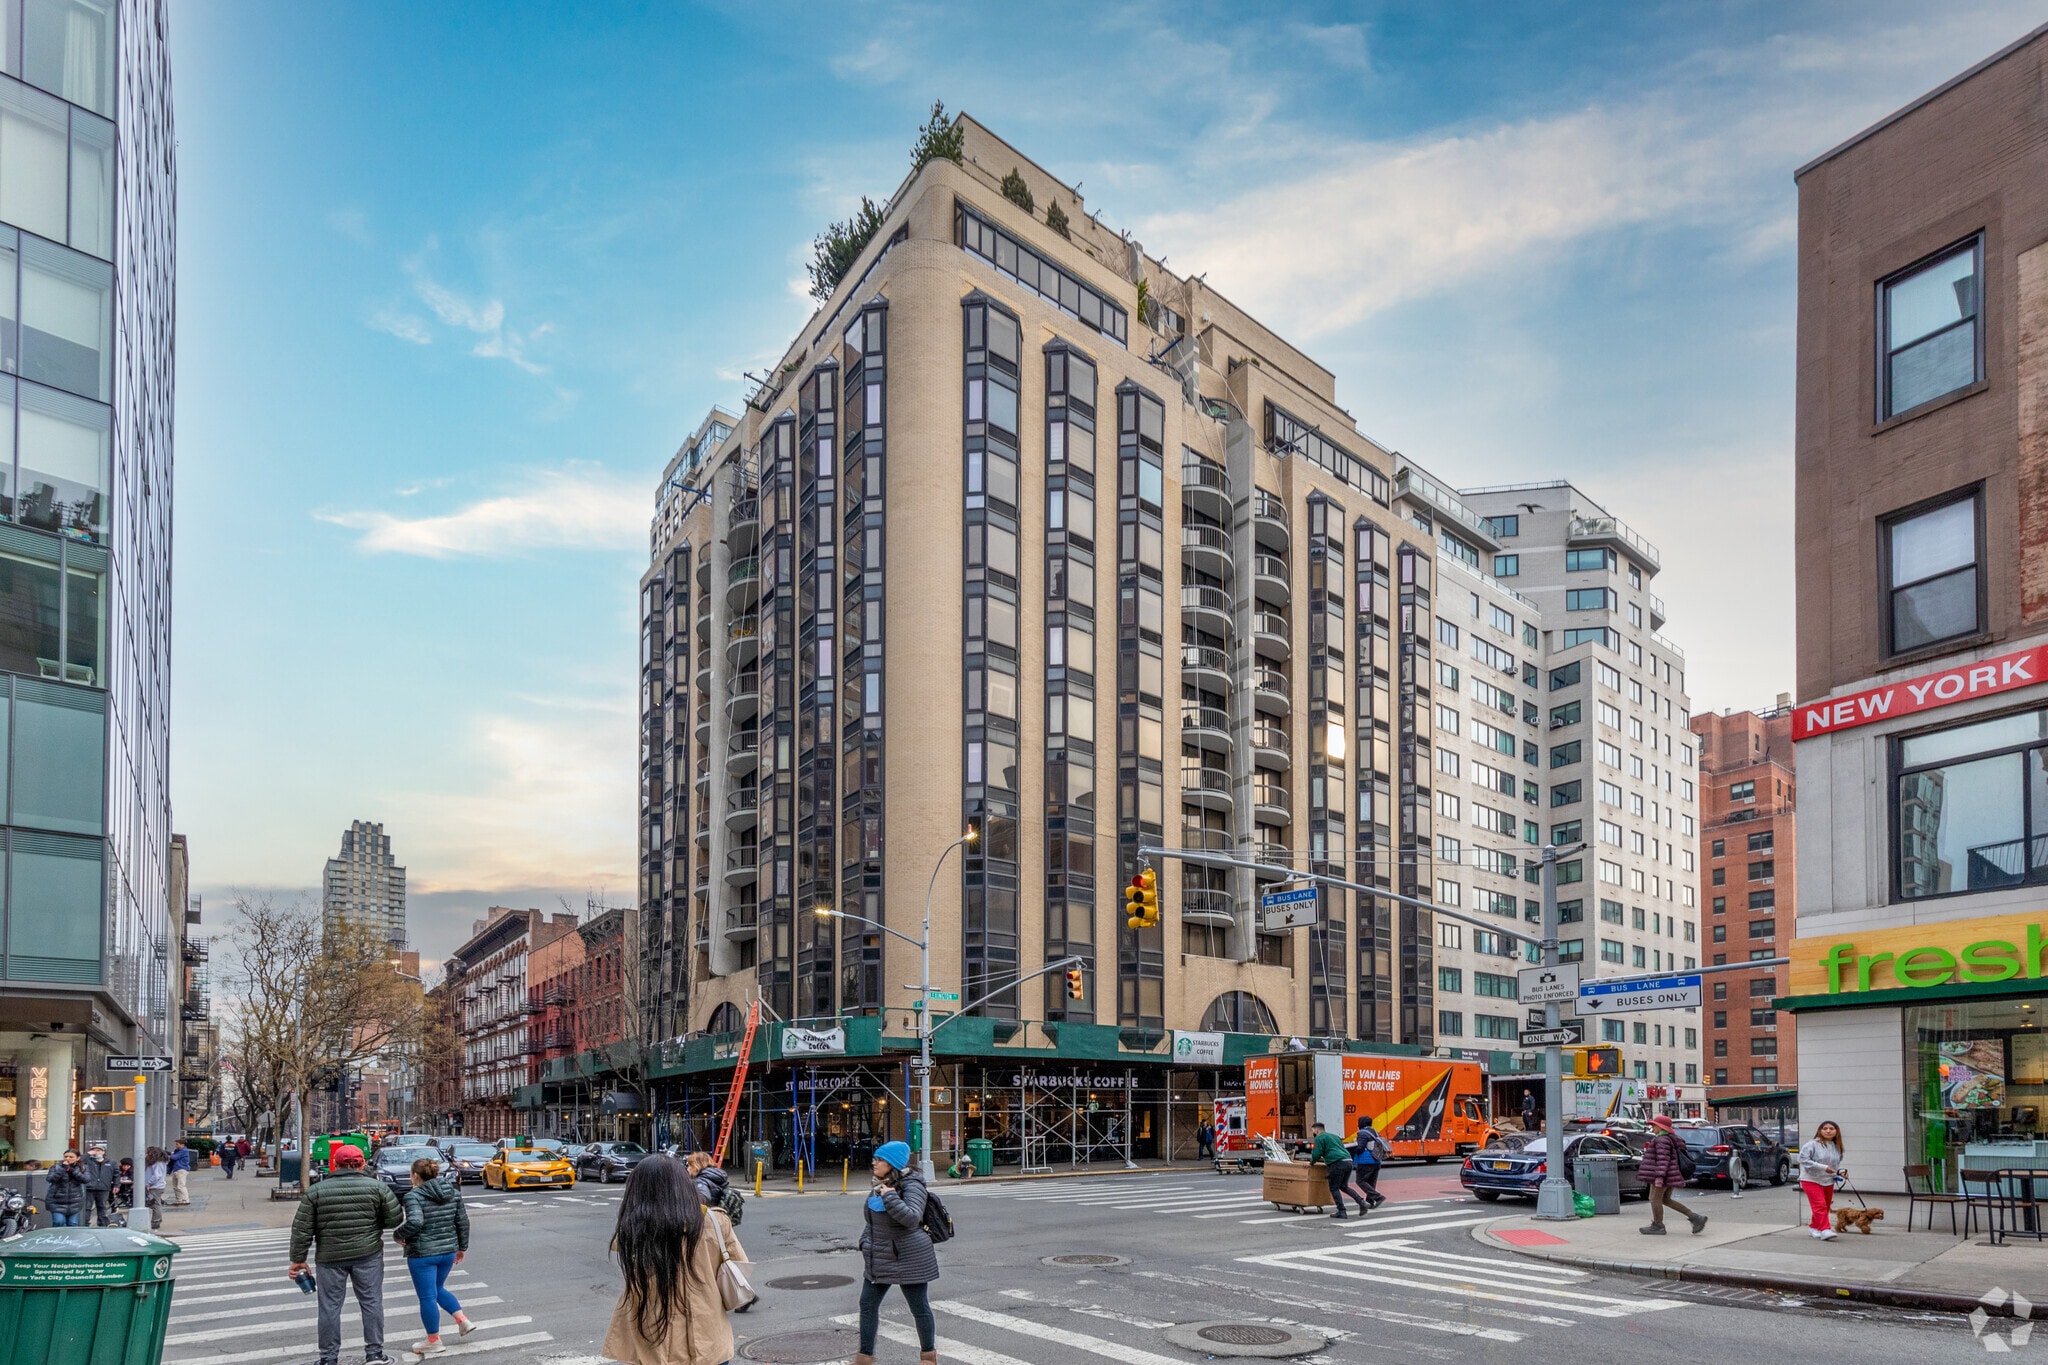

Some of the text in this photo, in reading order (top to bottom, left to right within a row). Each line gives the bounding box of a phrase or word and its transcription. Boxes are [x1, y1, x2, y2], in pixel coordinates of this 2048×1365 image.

[1807, 655, 2033, 731] NEW YORK
[1293, 891, 1313, 899] LANE
[1266, 900, 1314, 914] BUSES ONLY
[1611, 981, 1661, 993] BUS LANE
[1543, 991, 1574, 999] ENFORCED
[1616, 992, 1688, 1007] BUSES ONLY
[1552, 1033, 1571, 1041] WAY
[1248, 1068, 1273, 1079] LIFFEY
[1359, 1069, 1376, 1079] VAN
[1377, 1070, 1401, 1081] LINES
[785, 1077, 829, 1091] STRBCKS
[1250, 1079, 1273, 1090] MOVING
[1356, 1081, 1362, 1090] &
[1363, 1081, 1395, 1091] STORAGE
[30, 1066, 48, 1140] VARIETY
